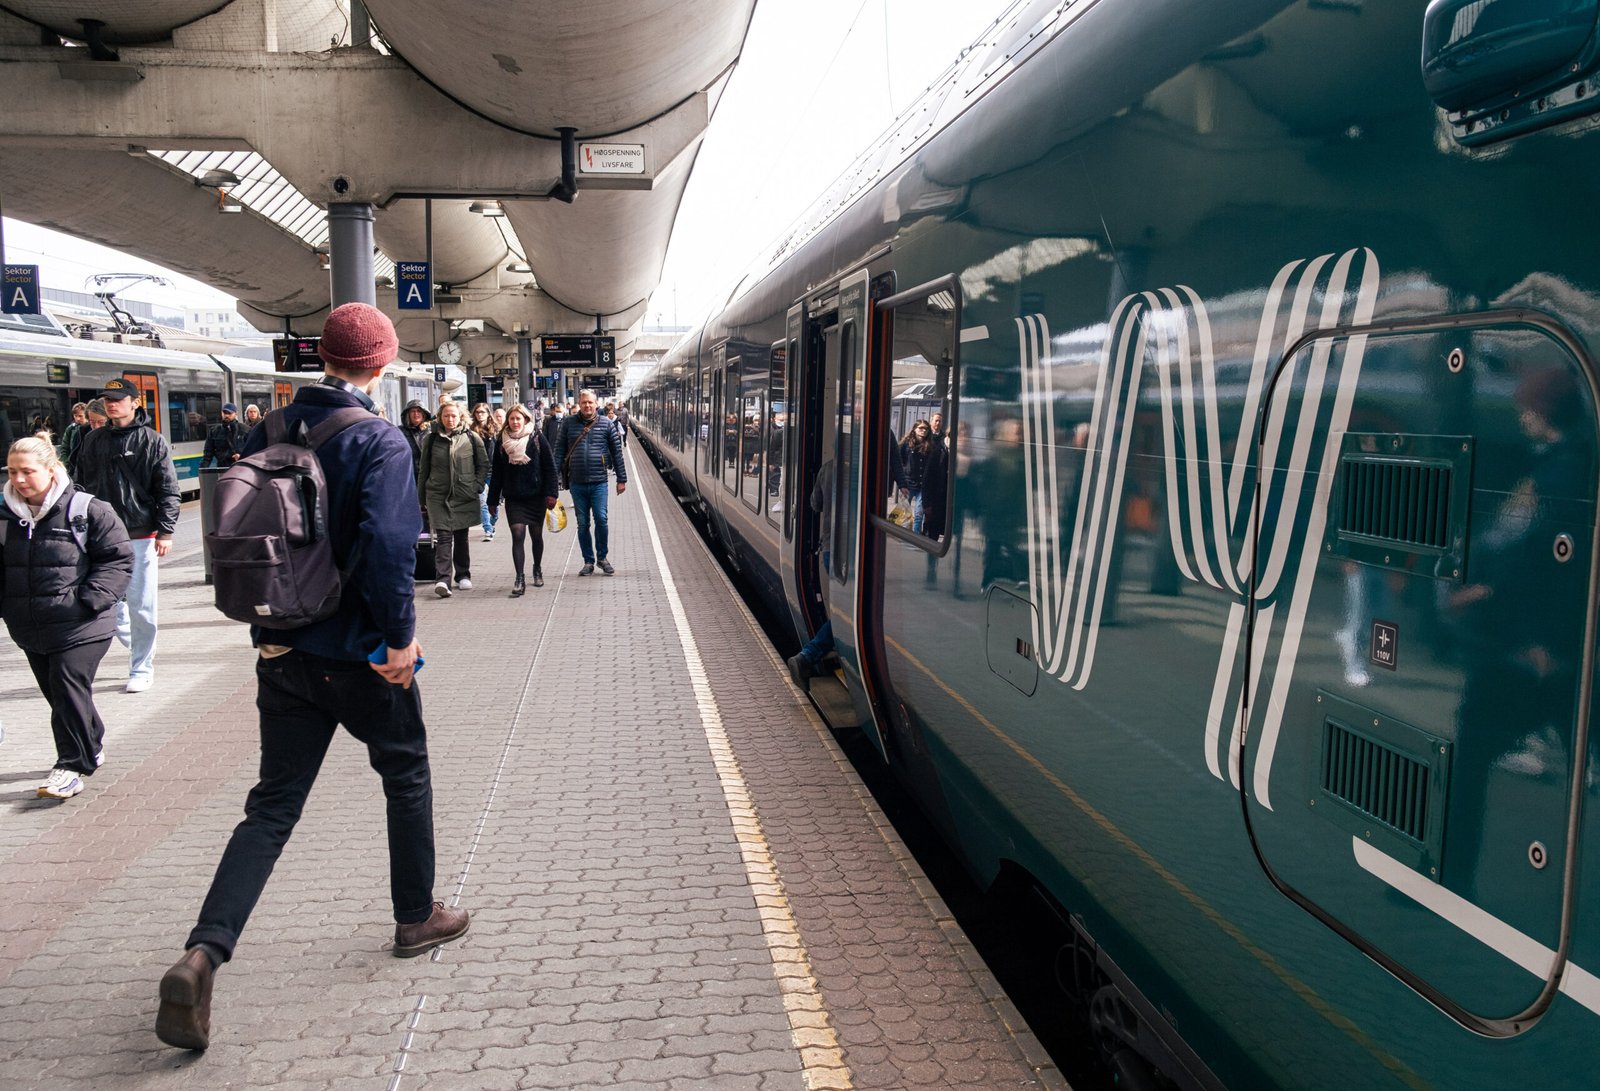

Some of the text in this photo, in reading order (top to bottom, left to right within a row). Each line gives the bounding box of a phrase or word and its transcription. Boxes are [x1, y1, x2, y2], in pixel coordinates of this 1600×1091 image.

[5, 267, 32, 275] Sektor
[401, 272, 426, 280] Sector
[11, 286, 29, 307] A
[406, 283, 423, 303] A
[280, 355, 288, 366] 7
[602, 352, 610, 362] 8
[1376, 650, 1391, 661] 110V
